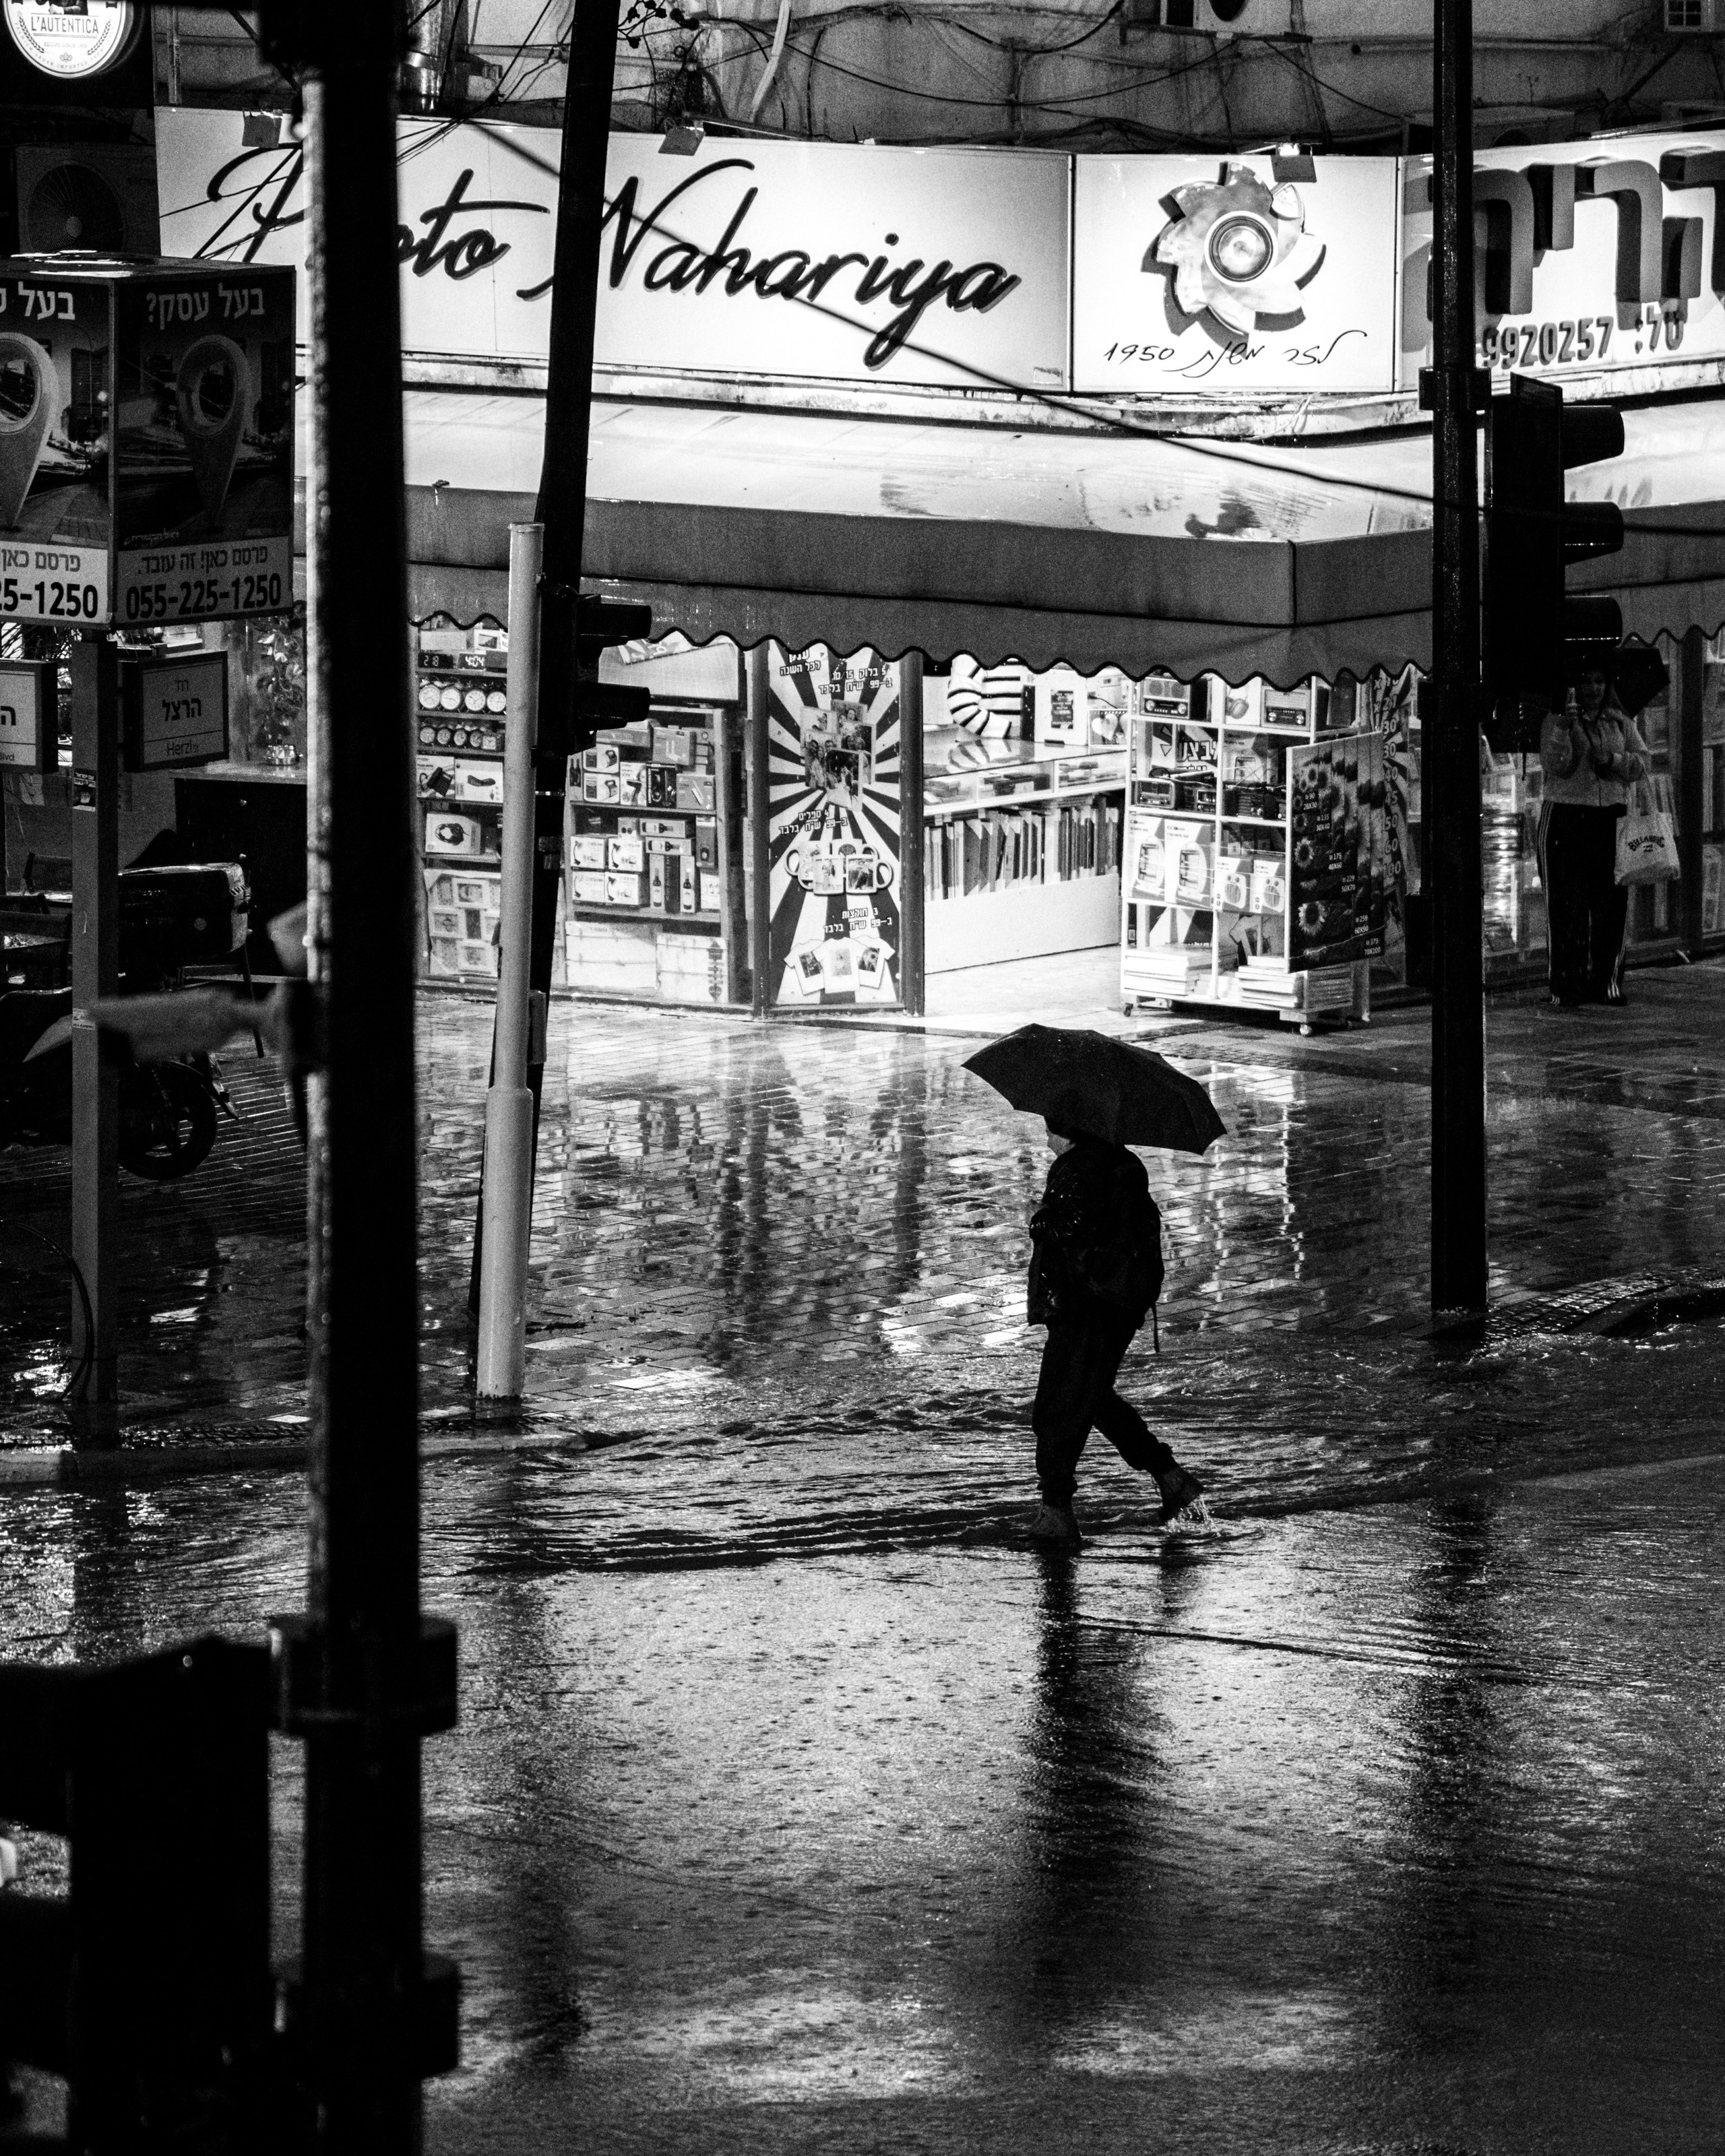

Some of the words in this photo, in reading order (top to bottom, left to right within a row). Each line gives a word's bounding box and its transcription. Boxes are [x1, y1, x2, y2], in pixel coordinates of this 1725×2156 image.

[31, 16, 99, 34] L'AUTENTICA
[18, 281, 75, 320] בעל
[218, 282, 265, 319] בעל
[146, 291, 210, 330] עסק?
[1103, 342, 1175, 365] 1950
[35, 552, 80, 572] פרסם
[180, 552, 196, 570] זה
[232, 546, 268, 566] פרסם
[0, 577, 98, 619] 5-1250
[126, 573, 281, 620] 055-225-1250
[780, 664, 803, 676] השנה
[805, 660, 821, 672] לכל
[858, 667, 879, 680] בלוק
[818, 683, 841, 695] בלבד
[162, 697, 201, 722] הרצל
[167, 739, 192, 755] Herzl
[798, 810, 821, 821] ספלים
[824, 809, 829, 817] 4
[778, 824, 800, 835] בלבד
[841, 908, 868, 919] חולצות
[873, 907, 878, 916] 3
[823, 923, 844, 933] בלבד
